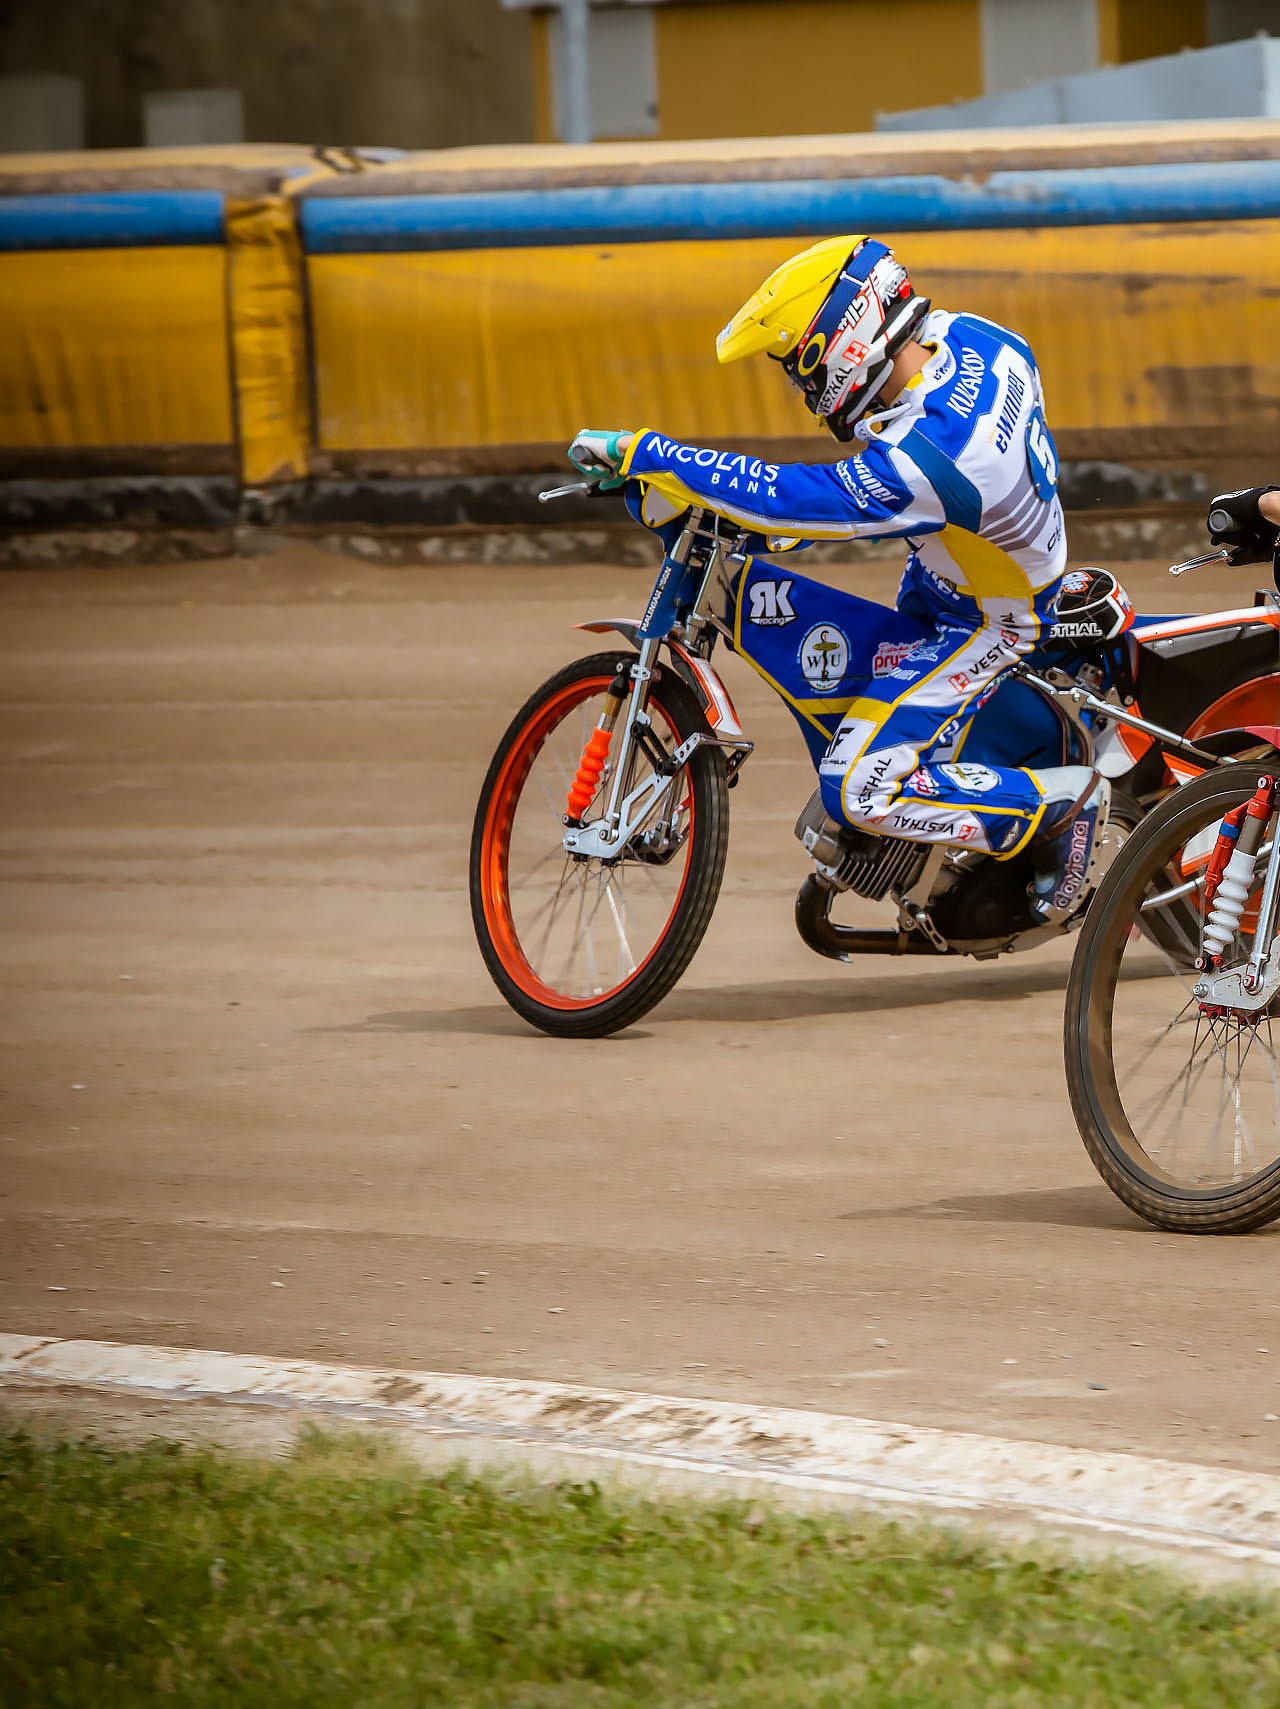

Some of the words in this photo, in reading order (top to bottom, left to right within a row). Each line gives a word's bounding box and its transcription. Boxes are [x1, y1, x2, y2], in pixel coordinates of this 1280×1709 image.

[647, 436, 780, 483] NICOLAUS
[1029, 416, 1057, 486] 5
[711, 472, 777, 498] BANK
[1049, 623, 1103, 639] STHAL
[893, 815, 954, 836] VESTHAL
